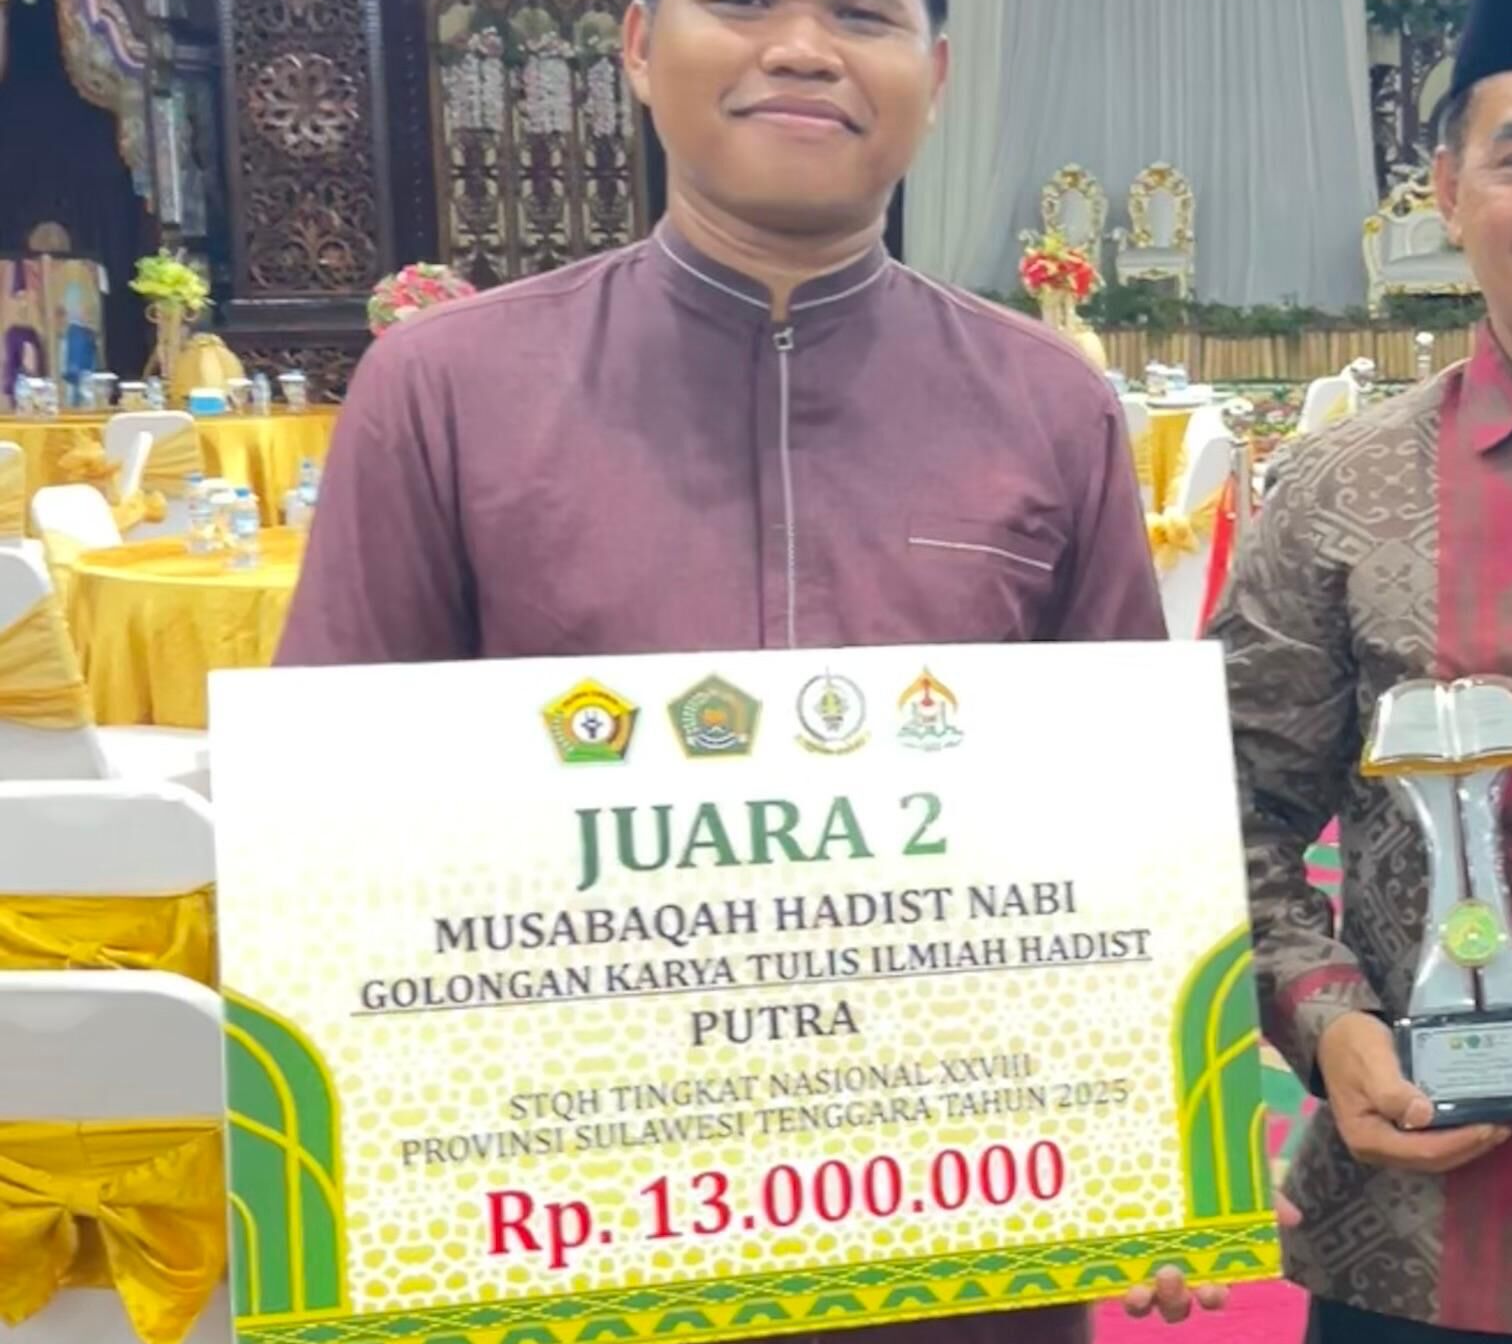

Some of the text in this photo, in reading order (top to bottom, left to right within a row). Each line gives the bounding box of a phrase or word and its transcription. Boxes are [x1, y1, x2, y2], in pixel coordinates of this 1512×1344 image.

[574, 792, 947, 892] JUARA 2
[434, 881, 1077, 953] MUSABAQAH HADIST NABI
[360, 929, 1151, 1010] GOLONGAN KARYA TULIS ILMIAH HADIST
[692, 1001, 858, 1046] PUTRA
[401, 1079, 1128, 1166] PROVINSI SULAWESI TENGGARA TAHUN 2025
[510, 1054, 1031, 1122] STQH TINGKAT NASIONAL XXVIII
[487, 1140, 1064, 1268] Rp. 13.000.000
